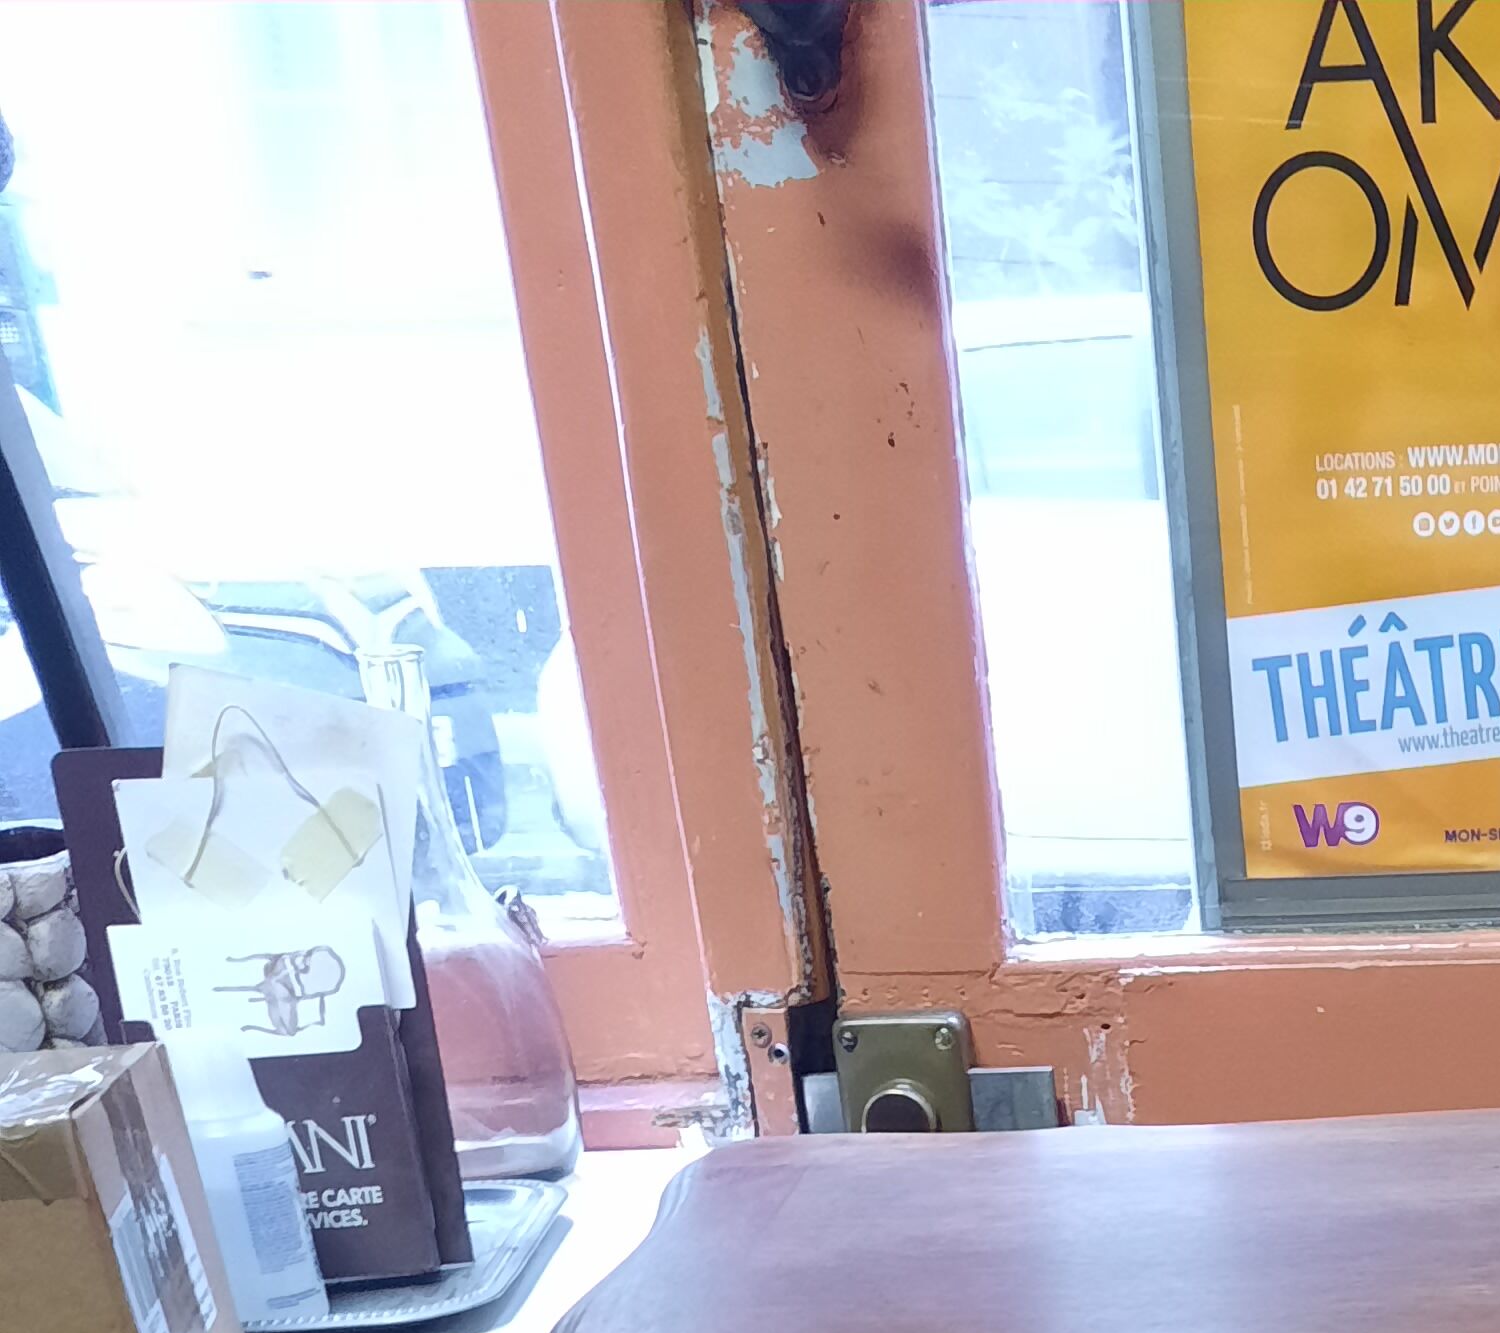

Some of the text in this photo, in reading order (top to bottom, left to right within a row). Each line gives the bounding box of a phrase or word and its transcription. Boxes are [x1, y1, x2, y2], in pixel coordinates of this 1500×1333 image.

[1315, 451, 1395, 472] LOCATIONS
[1316, 478, 1338, 499] 01
[1344, 477, 1368, 498] 42
[1372, 476, 1393, 497] 71
[1400, 475, 1422, 496] 50
[1427, 474, 1452, 495] 00
[1293, 801, 1380, 848] W9
[321, 1185, 384, 1208] CARTE
